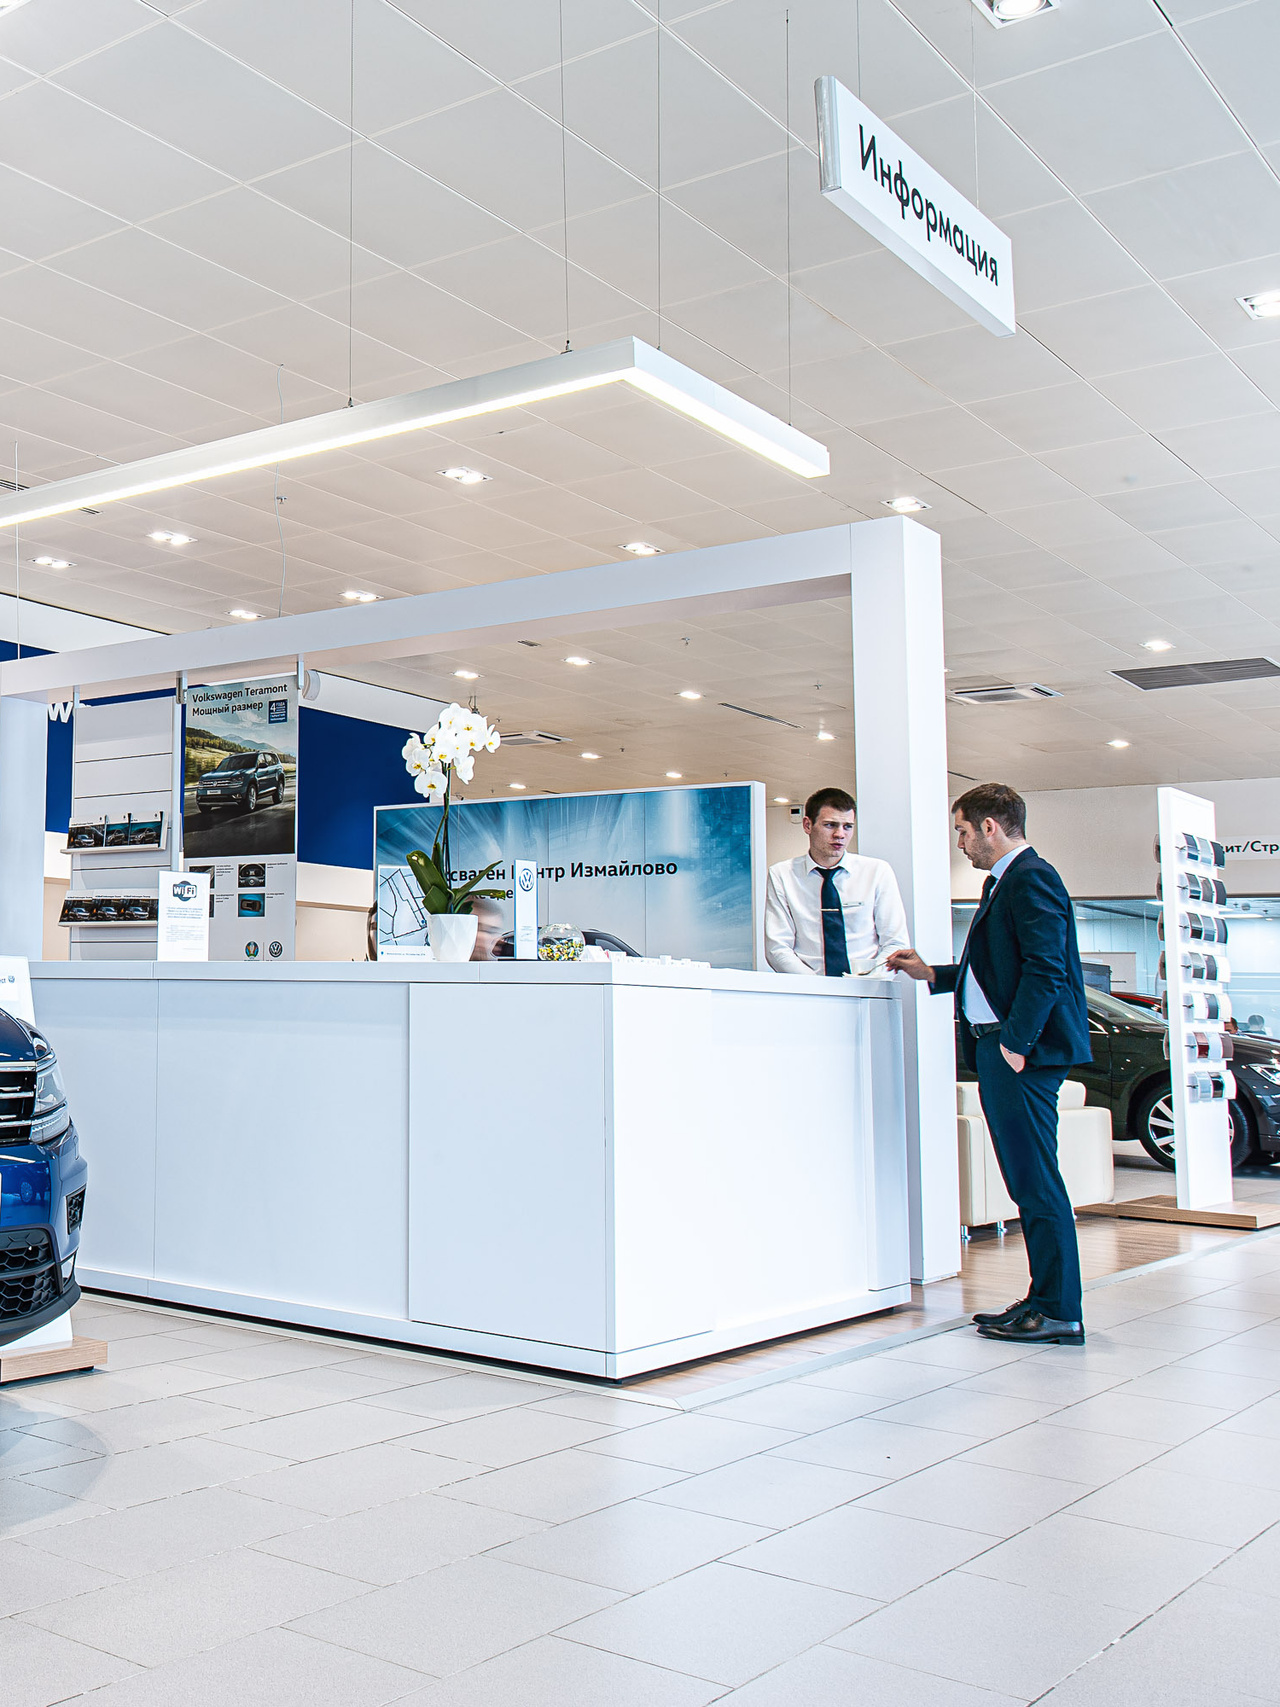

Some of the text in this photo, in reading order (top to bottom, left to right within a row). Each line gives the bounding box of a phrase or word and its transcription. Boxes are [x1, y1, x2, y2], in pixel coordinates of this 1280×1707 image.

[858, 123, 999, 286] Информация
[192, 683, 288, 703] Volkswagen Teramont
[192, 703, 230, 717] Мощный
[231, 701, 264, 714] размер
[1222, 840, 1280, 855] ит/Стр
[571, 860, 678, 878] Измайлово
